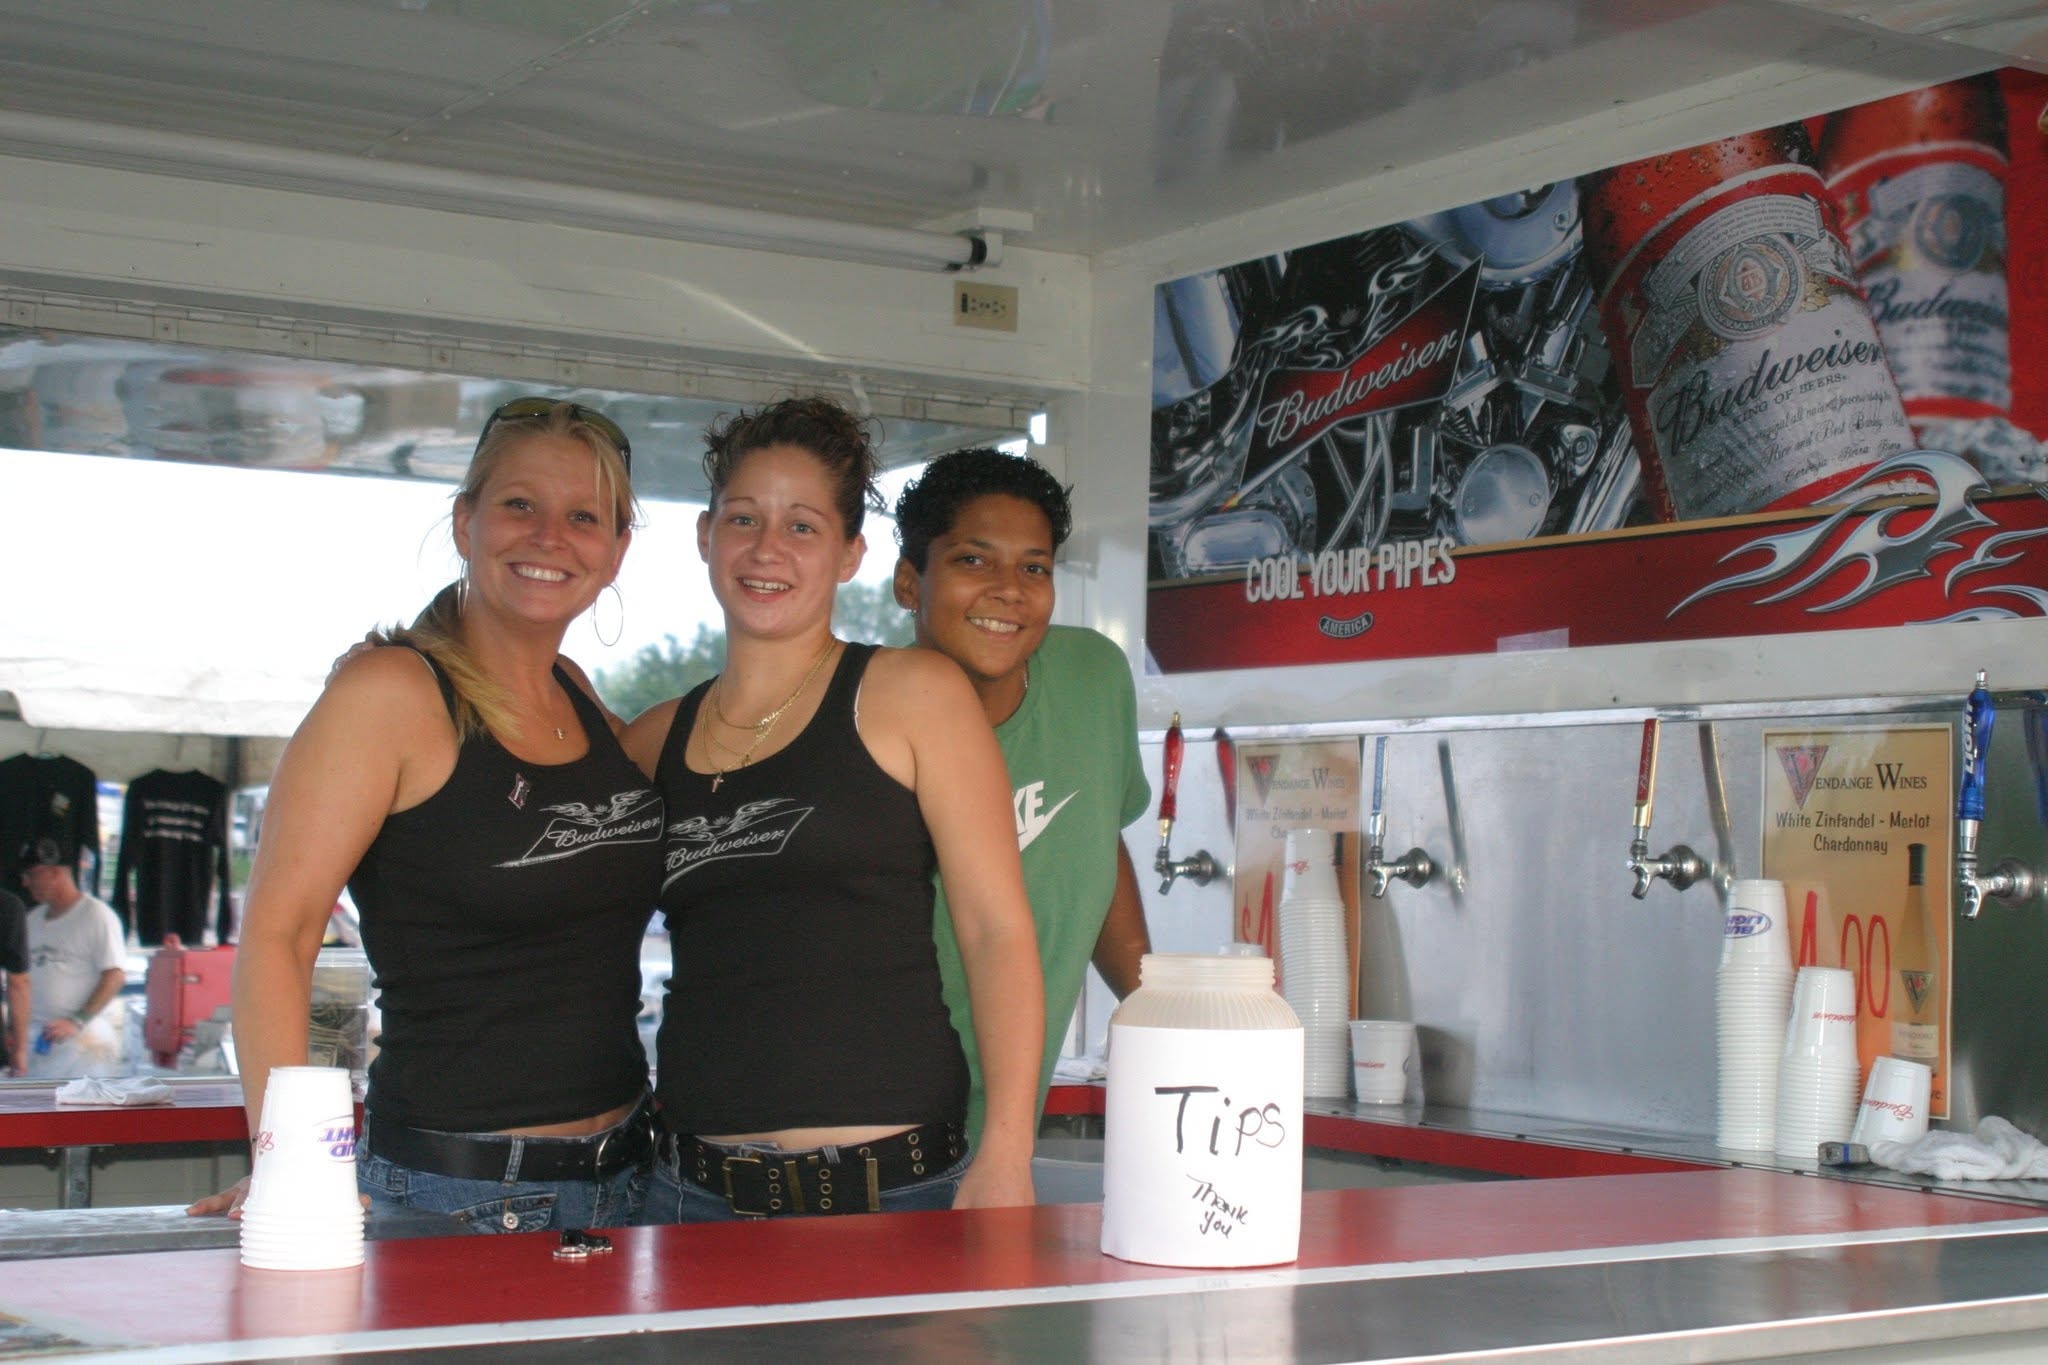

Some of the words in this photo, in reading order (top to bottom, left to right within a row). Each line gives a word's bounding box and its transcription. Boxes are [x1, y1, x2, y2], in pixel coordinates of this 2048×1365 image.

[1257, 329, 1458, 448] Budweiser
[1656, 329, 1884, 456] Budweiser
[1732, 401, 1768, 428] KING
[1774, 389, 1794, 404] OF
[1246, 556, 1304, 603] COOL
[1308, 548, 1371, 597] YOUR
[1377, 537, 1456, 591] PIPES
[1322, 616, 1370, 636] AMERICA
[1875, 763, 1928, 790] WINES
[1013, 780, 1045, 834] KE
[1776, 811, 1811, 828] White
[1815, 810, 1875, 828] Zinfandel
[1889, 813, 1931, 828] Merlot
[546, 816, 661, 848] Budweiser
[665, 828, 786, 871] Budweiser
[1813, 833, 1888, 855] Chardonnay
